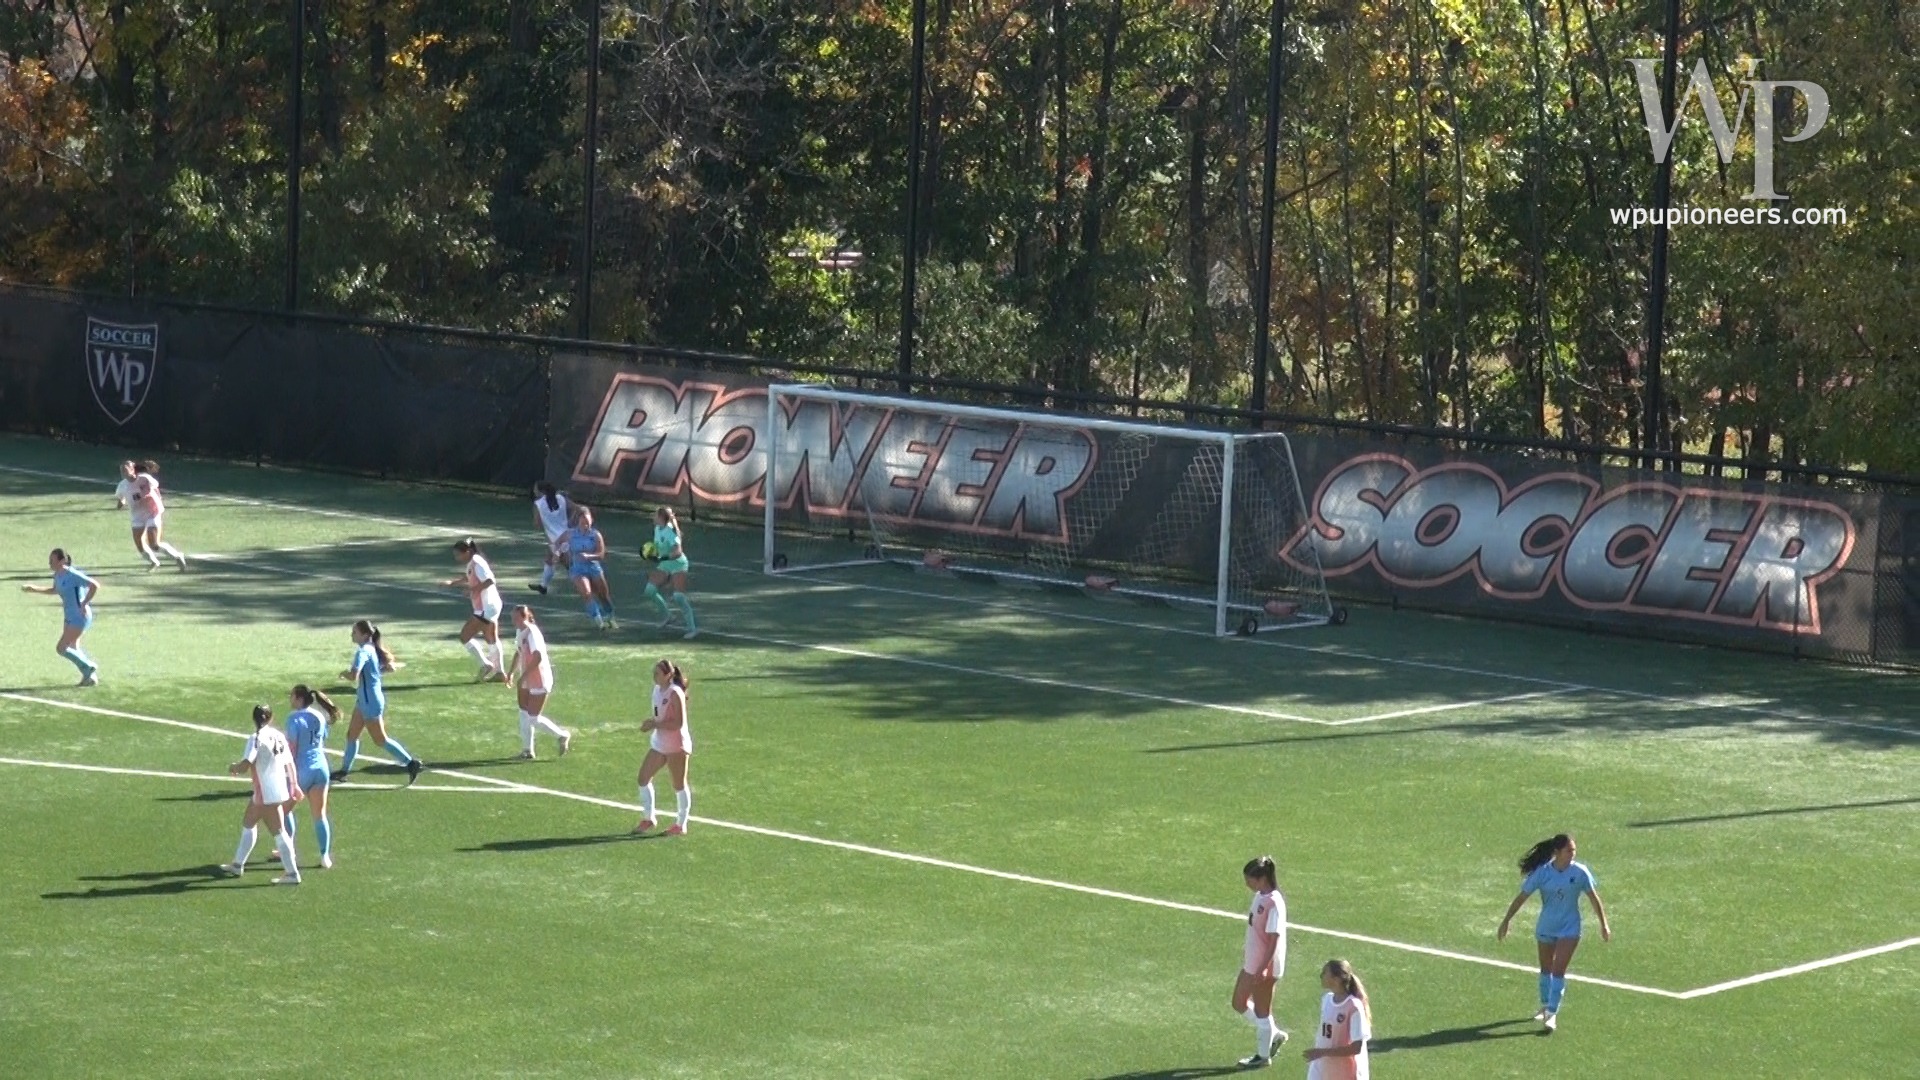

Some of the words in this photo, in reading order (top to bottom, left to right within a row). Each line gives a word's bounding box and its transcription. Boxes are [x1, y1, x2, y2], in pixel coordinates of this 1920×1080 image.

[91, 328, 152, 345] SOCCER
[93, 348, 146, 405] WP
[571, 372, 1099, 543] PIONEER
[1278, 452, 1856, 635] SOCCER
